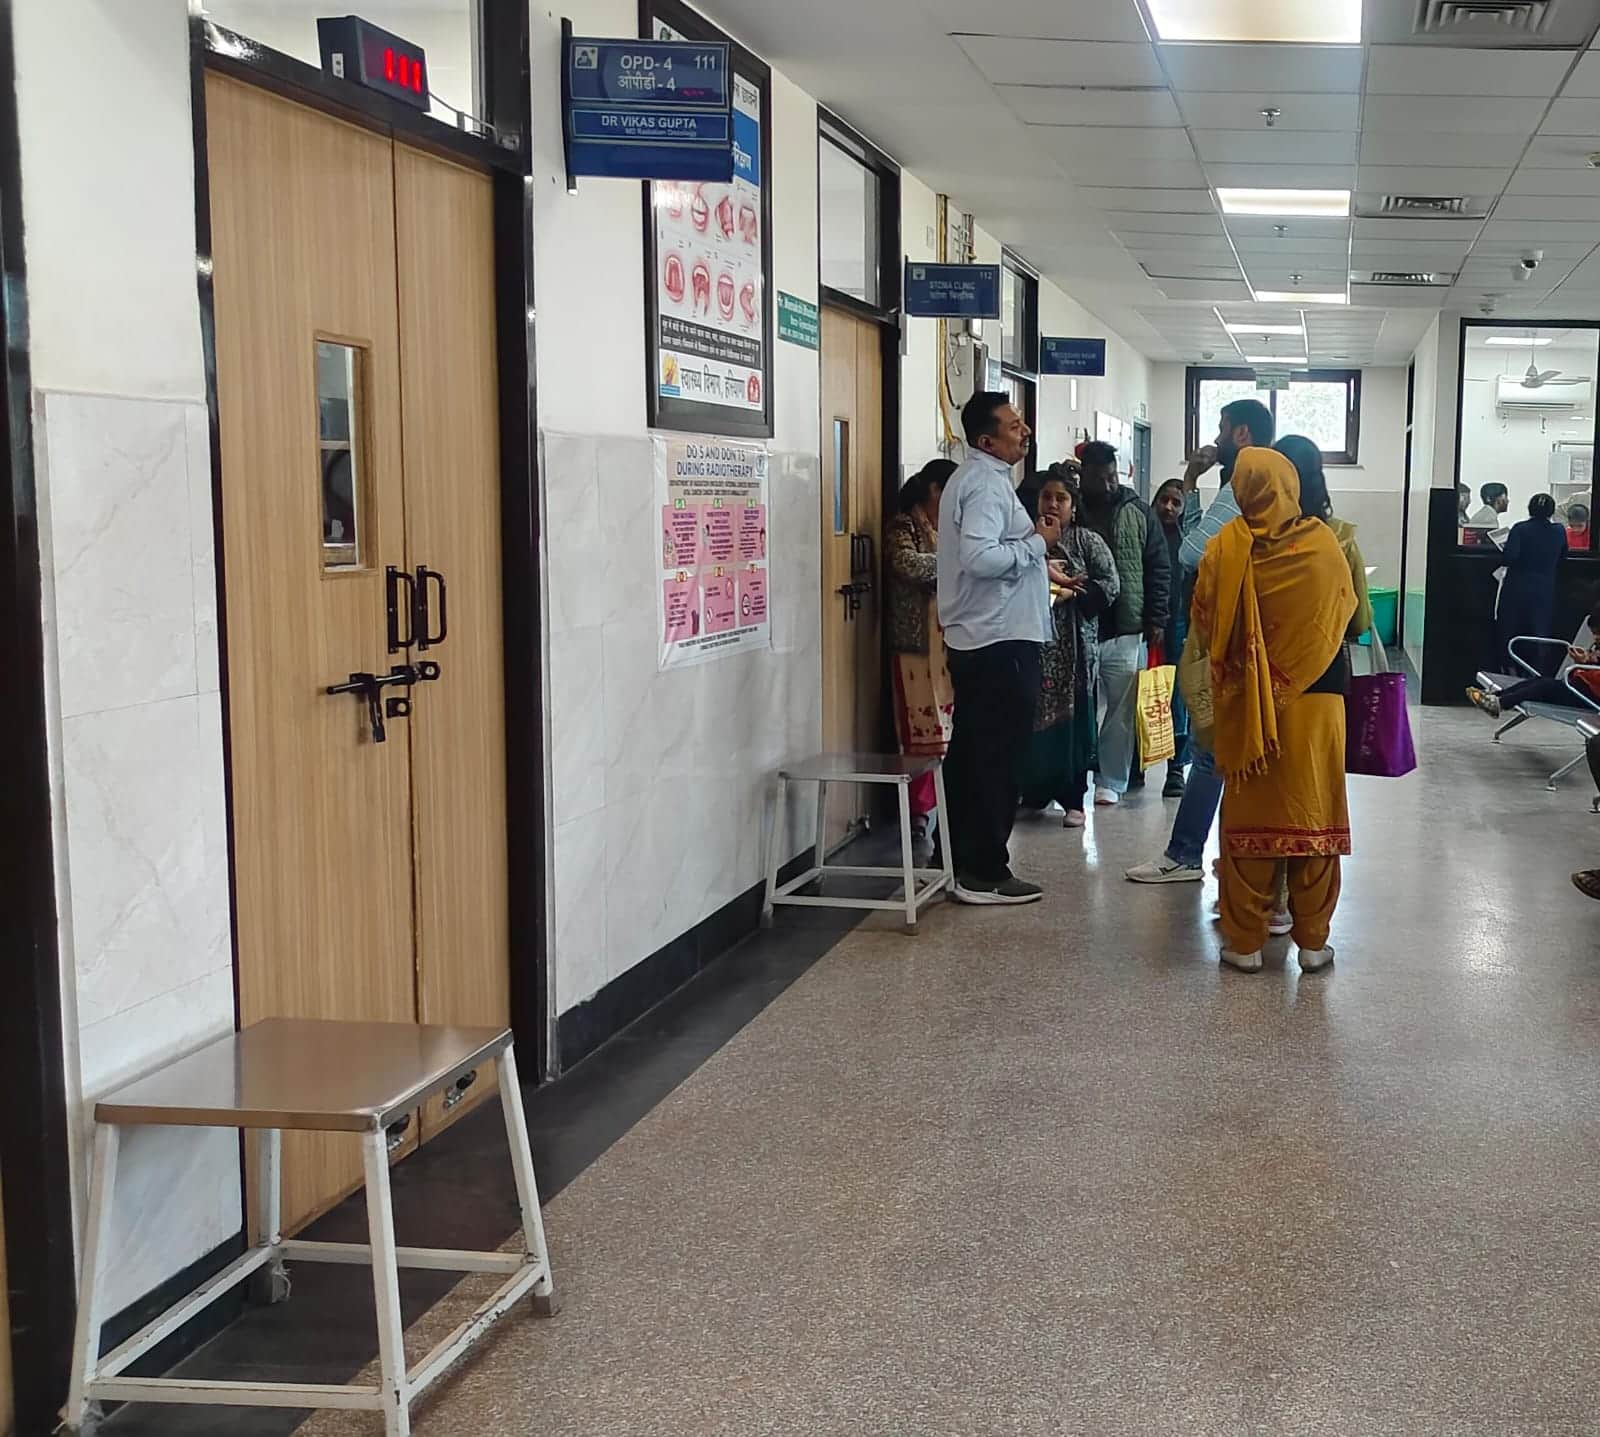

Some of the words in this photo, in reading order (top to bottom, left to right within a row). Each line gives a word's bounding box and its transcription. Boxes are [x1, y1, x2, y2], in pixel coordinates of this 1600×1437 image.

[693, 55, 716, 69] 111
[601, 115, 618, 126] DR
[621, 116, 655, 128] VIKAS
[658, 117, 697, 129] GUPTA
[705, 446, 720, 460] AND
[676, 461, 705, 476] DURING
[706, 463, 753, 478] RADIOTHERAPY
